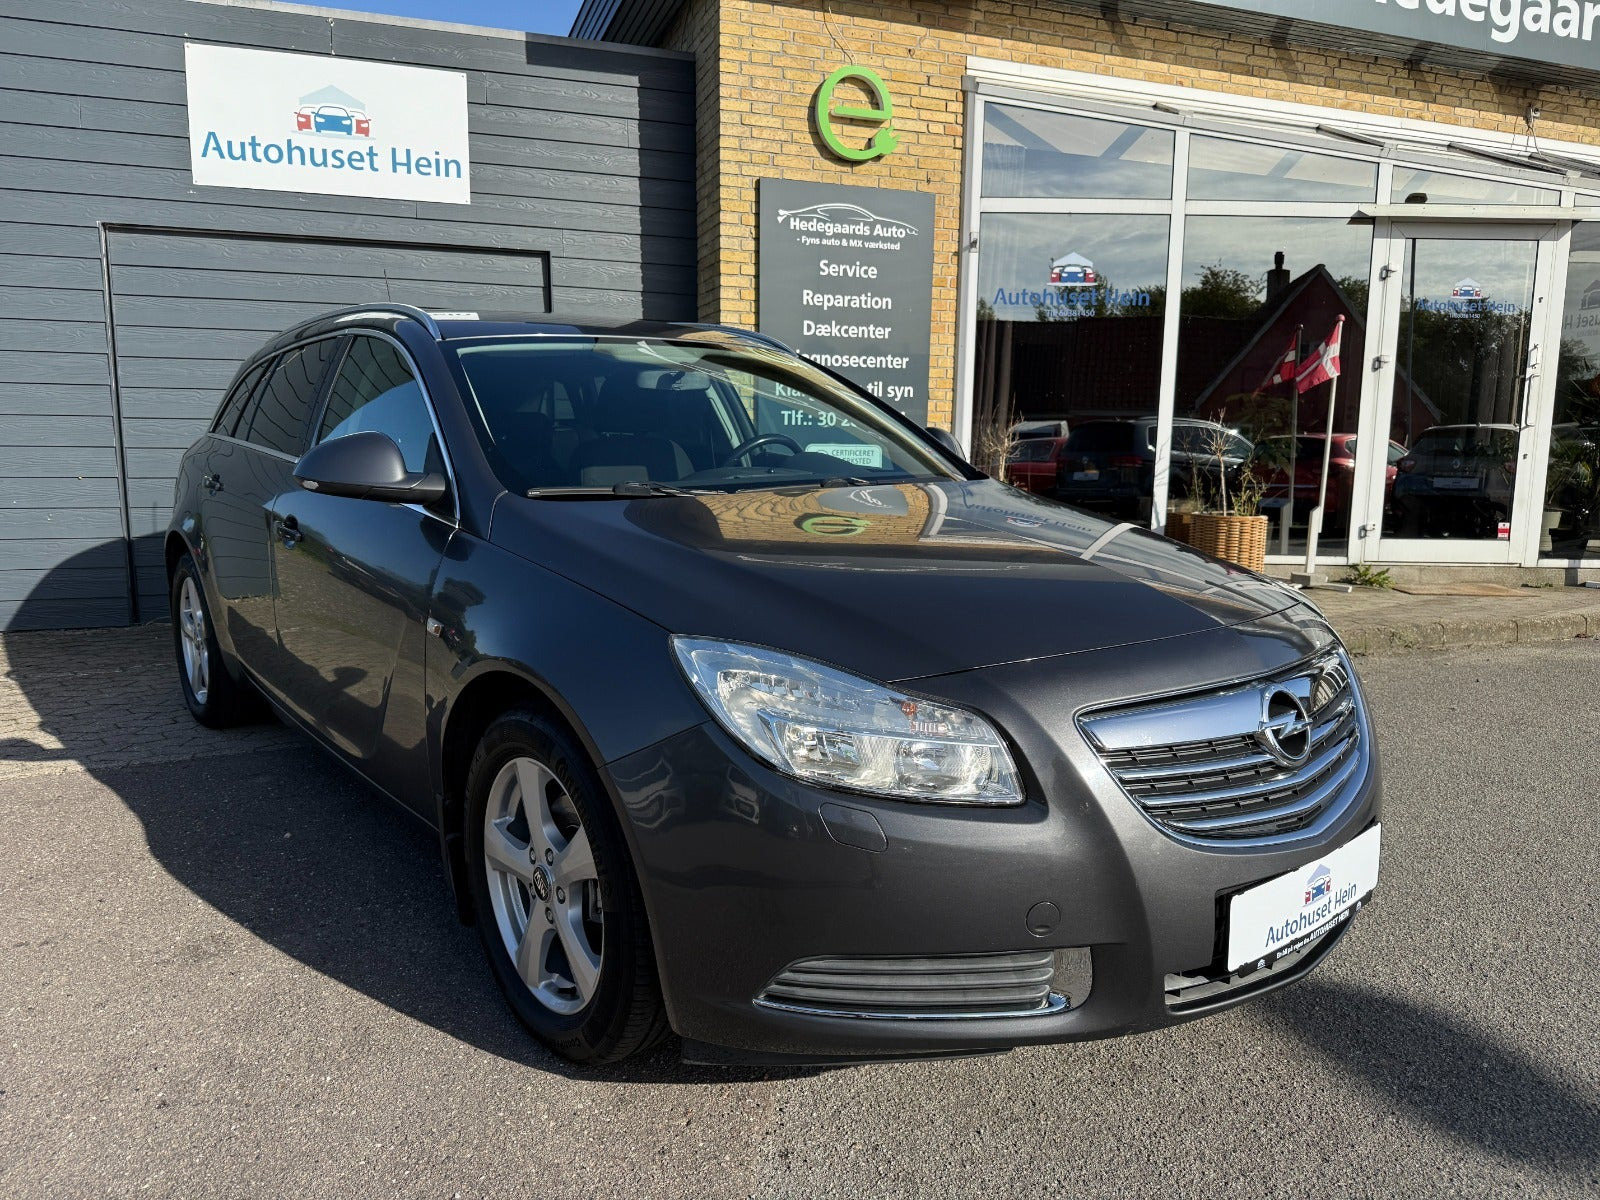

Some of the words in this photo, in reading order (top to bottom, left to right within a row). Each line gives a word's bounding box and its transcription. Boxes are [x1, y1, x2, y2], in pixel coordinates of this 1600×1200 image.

[201, 131, 379, 172] Autohuset
[391, 147, 462, 179] Hein
[789, 217, 870, 236] Hedegaards
[873, 224, 906, 239] Auto
[801, 235, 820, 246] Fyns
[821, 238, 840, 247] auto
[841, 239, 849, 247] &
[849, 239, 863, 248] MX
[864, 241, 901, 251] værksted
[819, 259, 878, 279] Service
[802, 289, 892, 310] Reparation
[993, 287, 1099, 306] Autohuset
[1105, 288, 1151, 307] Hein
[1416, 298, 1483, 313] Autohuset
[1486, 300, 1517, 314] Hein
[803, 320, 892, 339] Dækcenter
[796, 349, 910, 369] nosecenter
[866, 381, 883, 397] til
[887, 385, 914, 402] syn
[781, 410, 813, 426] Tlf.:
[817, 411, 837, 427] 30
[831, 449, 875, 457] CERTIFICERET
[1265, 897, 1332, 948] Autohuset
[1334, 882, 1357, 910] Hein
